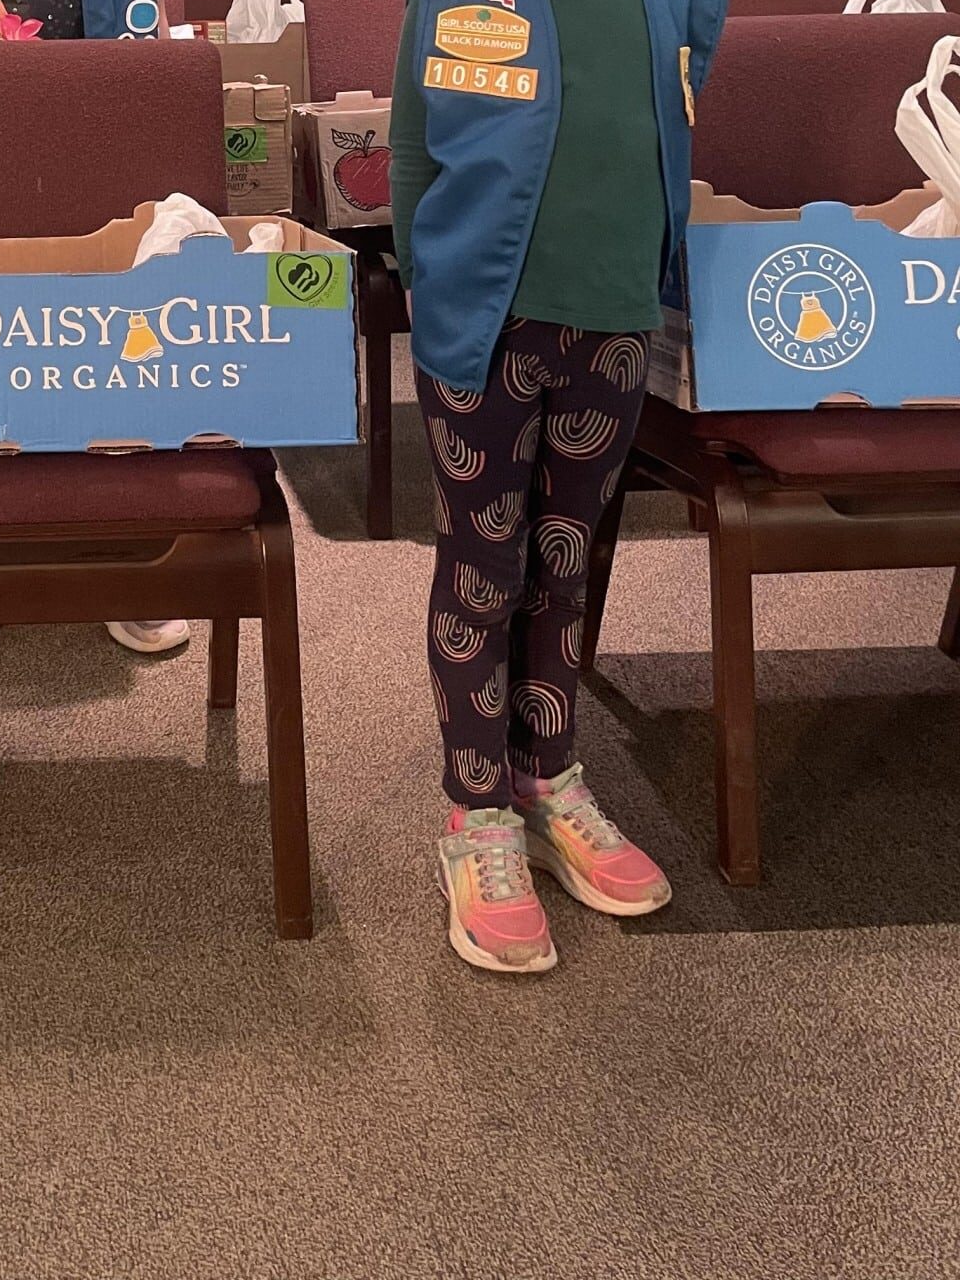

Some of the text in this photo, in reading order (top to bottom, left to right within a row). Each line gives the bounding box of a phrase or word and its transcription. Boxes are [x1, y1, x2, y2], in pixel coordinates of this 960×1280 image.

[440, 18, 526, 35] GIRL SCOUTS USA
[441, 34, 522, 51] BLACK DIAMOND
[433, 61, 531, 95] 10546
[754, 250, 865, 304] DAISY GIRL
[159, 297, 291, 345] GIRL
[759, 316, 866, 364] ORGANICS
